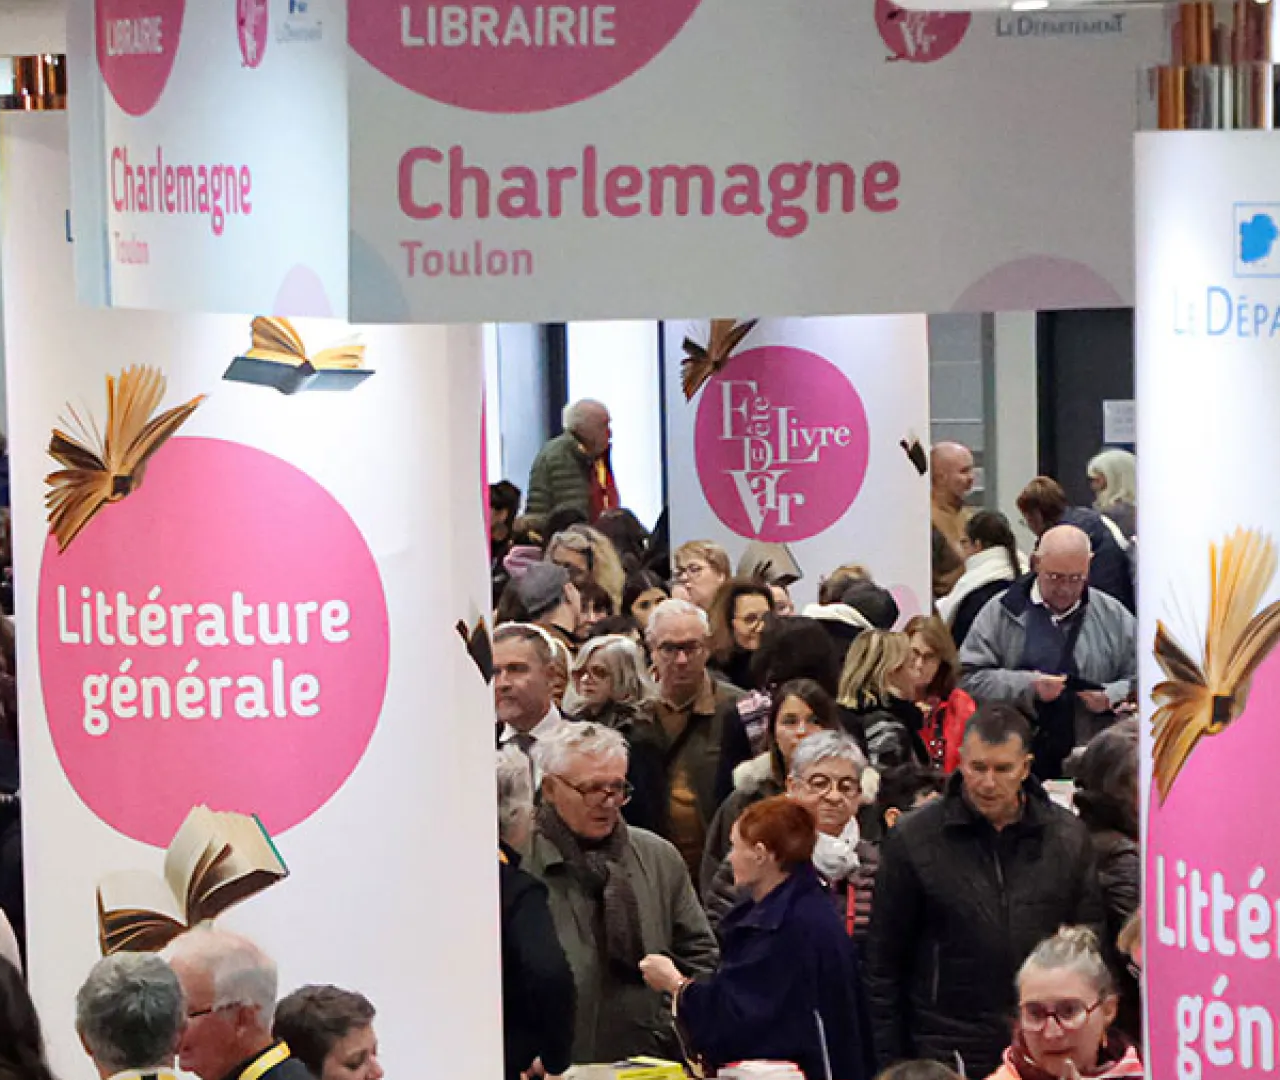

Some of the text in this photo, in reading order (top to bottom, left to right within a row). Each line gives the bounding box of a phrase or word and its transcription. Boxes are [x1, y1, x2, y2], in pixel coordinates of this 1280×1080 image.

[400, 5, 617, 48] LIBRAIRIE
[110, 145, 253, 236] Charlemagne
[397, 144, 901, 239] Charlemagne
[399, 240, 534, 278] Toulon
[771, 405, 852, 465] Livre
[57, 584, 351, 647] Littérature
[82, 657, 320, 736] générale
